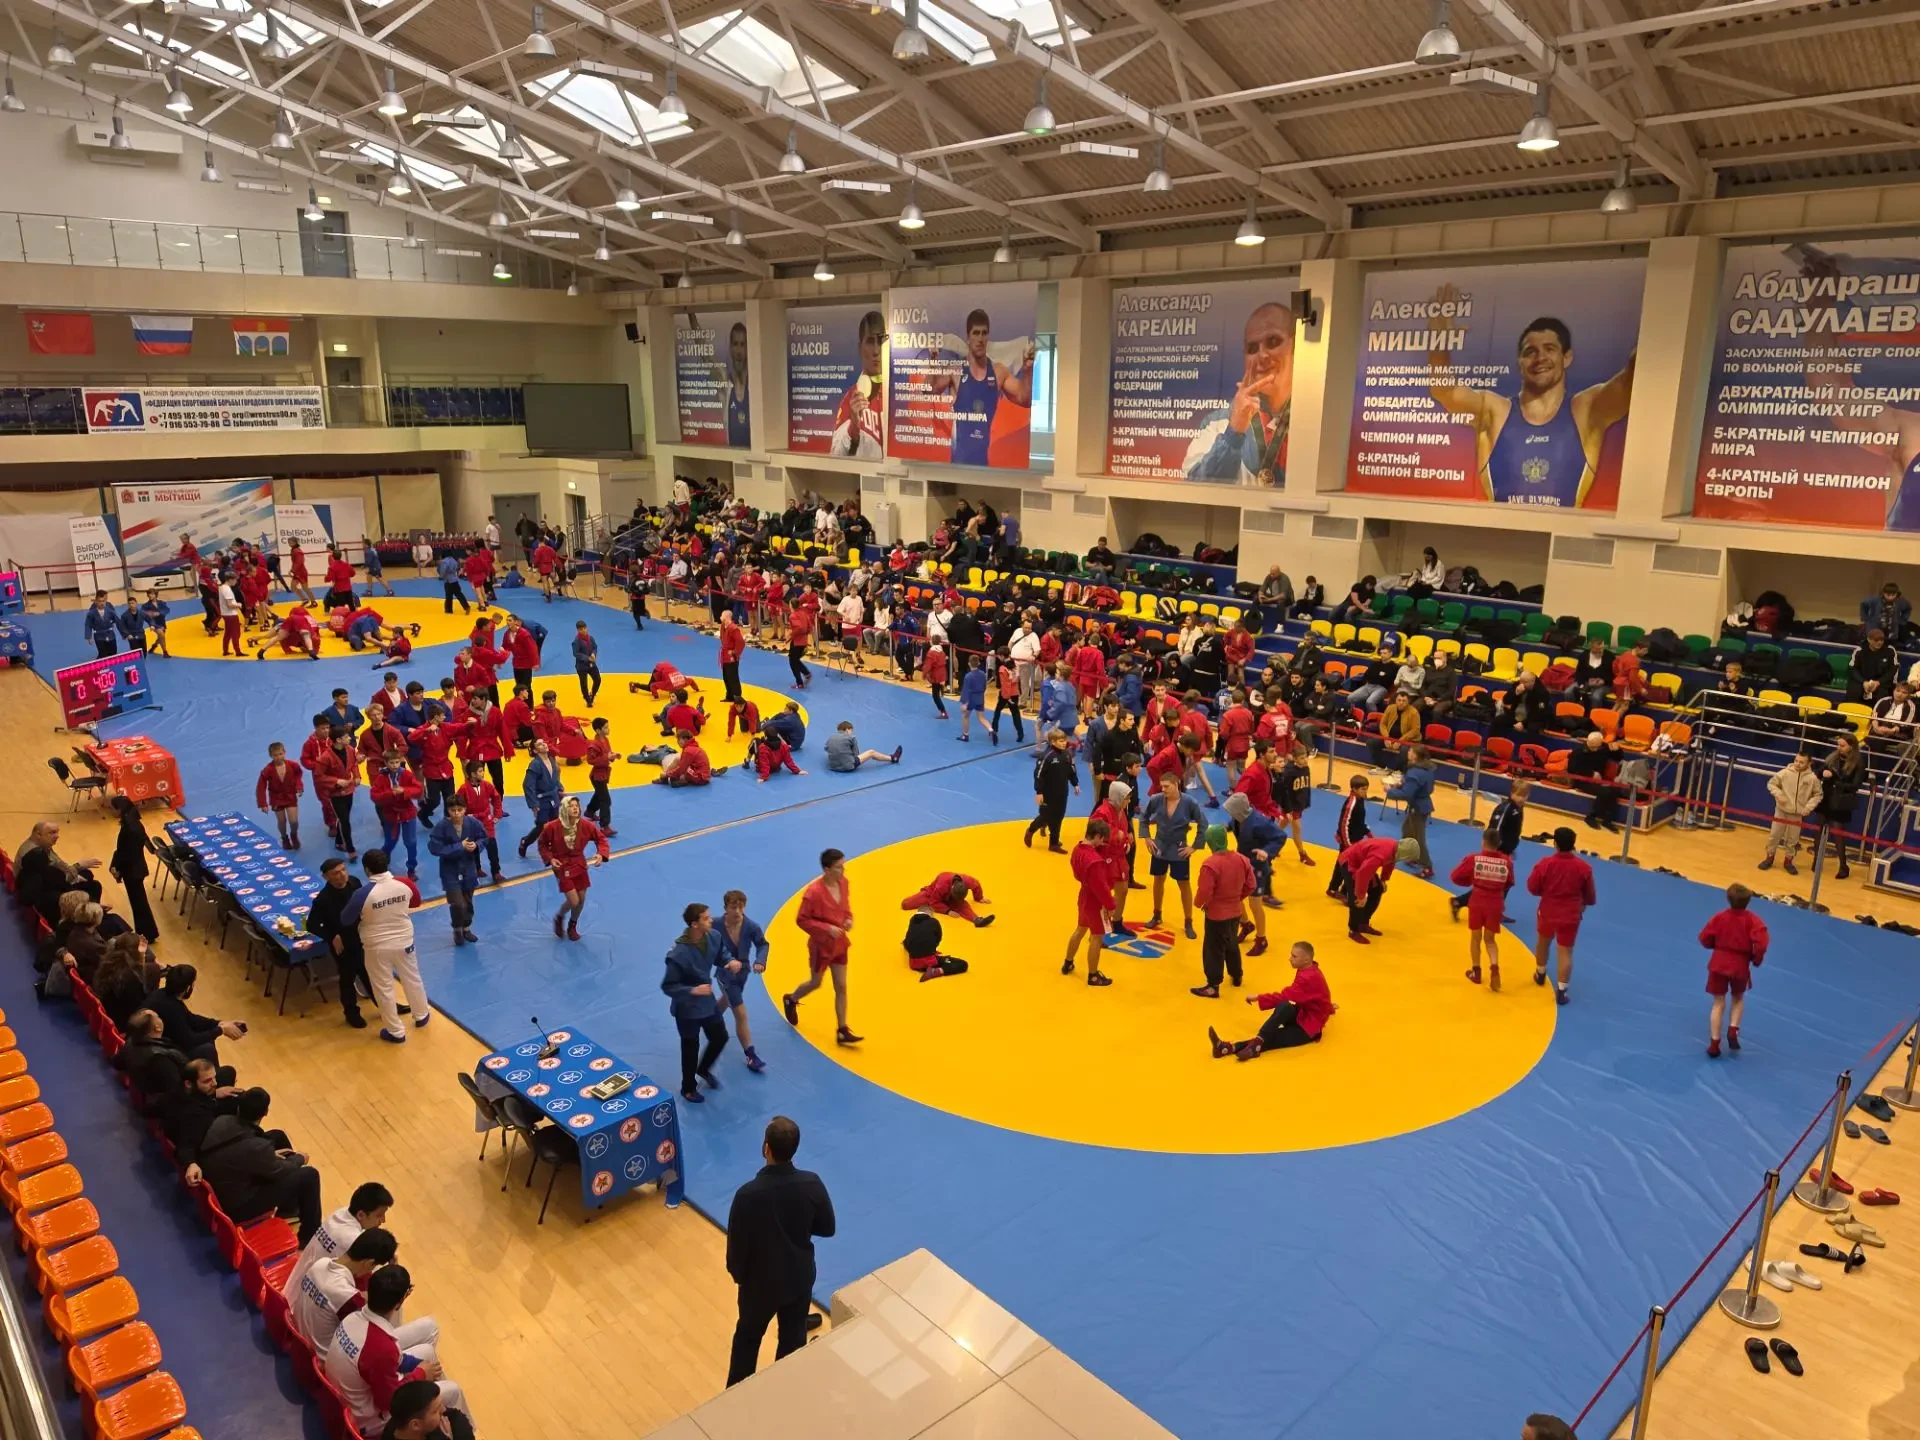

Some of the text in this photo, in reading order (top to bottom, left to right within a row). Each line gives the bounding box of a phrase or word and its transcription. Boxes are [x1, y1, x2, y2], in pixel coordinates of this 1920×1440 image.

[1735, 271, 1920, 303] Абдулраш
[1119, 293, 1212, 313] Александр
[1370, 294, 1473, 321] Алексей
[893, 308, 929, 324] МУСА
[1729, 305, 1917, 339] САДУЛАЕВ
[790, 322, 823, 335] Роман
[1117, 317, 1197, 337] КАРЕЛИН
[893, 332, 945, 348] ЕВЛОЕВ
[1368, 329, 1466, 352] МИШИН
[791, 341, 830, 356] ВЛАСОВ
[1116, 343, 1218, 354] ЗАСЛУЖЕННЫЙ МАСТЕР СПОРТА
[1725, 345, 1824, 358] ЗАСЛУЖЕННЫЙ
[1827, 347, 1882, 358] МАСТЕР
[1115, 353, 1210, 363] ПО ГРЕКО-РИМСКОЙ БОРЬБЕ
[1366, 364, 1510, 375] ЗАСЛУЖЕННЫЙ МАСТЕР СПОРТА
[1723, 358, 1863, 374] ПО ВОЛЬНОЙ БОРЬБЕ
[1114, 367, 1199, 380] ГЕРОЙ РОССИЙСКОЙ
[894, 382, 933, 392] ПОБЕДИТЕЛЬ
[1113, 381, 1163, 392] ФЕДЕРАЦИИ
[1365, 376, 1499, 387] ПО ГРЕКО-РИМСКОЙ БОРЬБЕ
[1719, 383, 1834, 400] ДВУКРАТНЫЙ
[1173, 399, 1230, 410] ПОБЕДИТЕЛЬ
[1364, 396, 1435, 409] ПОБЕДИТЕЛЬ
[1718, 400, 1885, 418] ОЛИМПИЙСКИХ ИГР
[895, 408, 987, 422] ДВУКРАТНЫЙ ЧЕМПИОН МИРА
[1113, 407, 1194, 420] ОЛИМПИЙСКИХ ИГР
[1362, 409, 1476, 424] ОЛИМПИЙСКИХ ИГР
[896, 433, 952, 446] ЧЕМПИОН ЕВРОПЫ
[1158, 428, 1201, 439] ЧЕМПИОН
[1360, 431, 1451, 446] ЧЕМПИОН МИРА
[1713, 425, 1900, 445] 5-КРАТНЫЙ ЧЕМПИОН
[1112, 437, 1135, 447] МИРА
[1711, 442, 1756, 457] МИРА
[1111, 454, 1161, 466] 12-КРАТНЫЙ
[1357, 452, 1421, 466] 6-КРАТНЫЙ
[1111, 465, 1151, 476] ЧЕМПИОН
[1357, 464, 1465, 481] ЧЕМПИОН ЕВРОПЫ
[1706, 467, 1891, 490] 4-КРАТНЫЙ ЧЕМПИОН
[154, 492, 201, 502] МЫТИЩИ
[1704, 483, 1774, 500] ЕВРОПЫ
[280, 529, 314, 537] ВЫБОР
[76, 542, 105, 554] ВЫБОР
[280, 537, 327, 545] СЬНЫХ
[77, 550, 116, 562] СИЛЬНЫХ
[154, 577, 170, 587] 2
[130, 668, 140, 685] 0
[76, 683, 87, 700] 0
[371, 894, 407, 910] REFEREE
